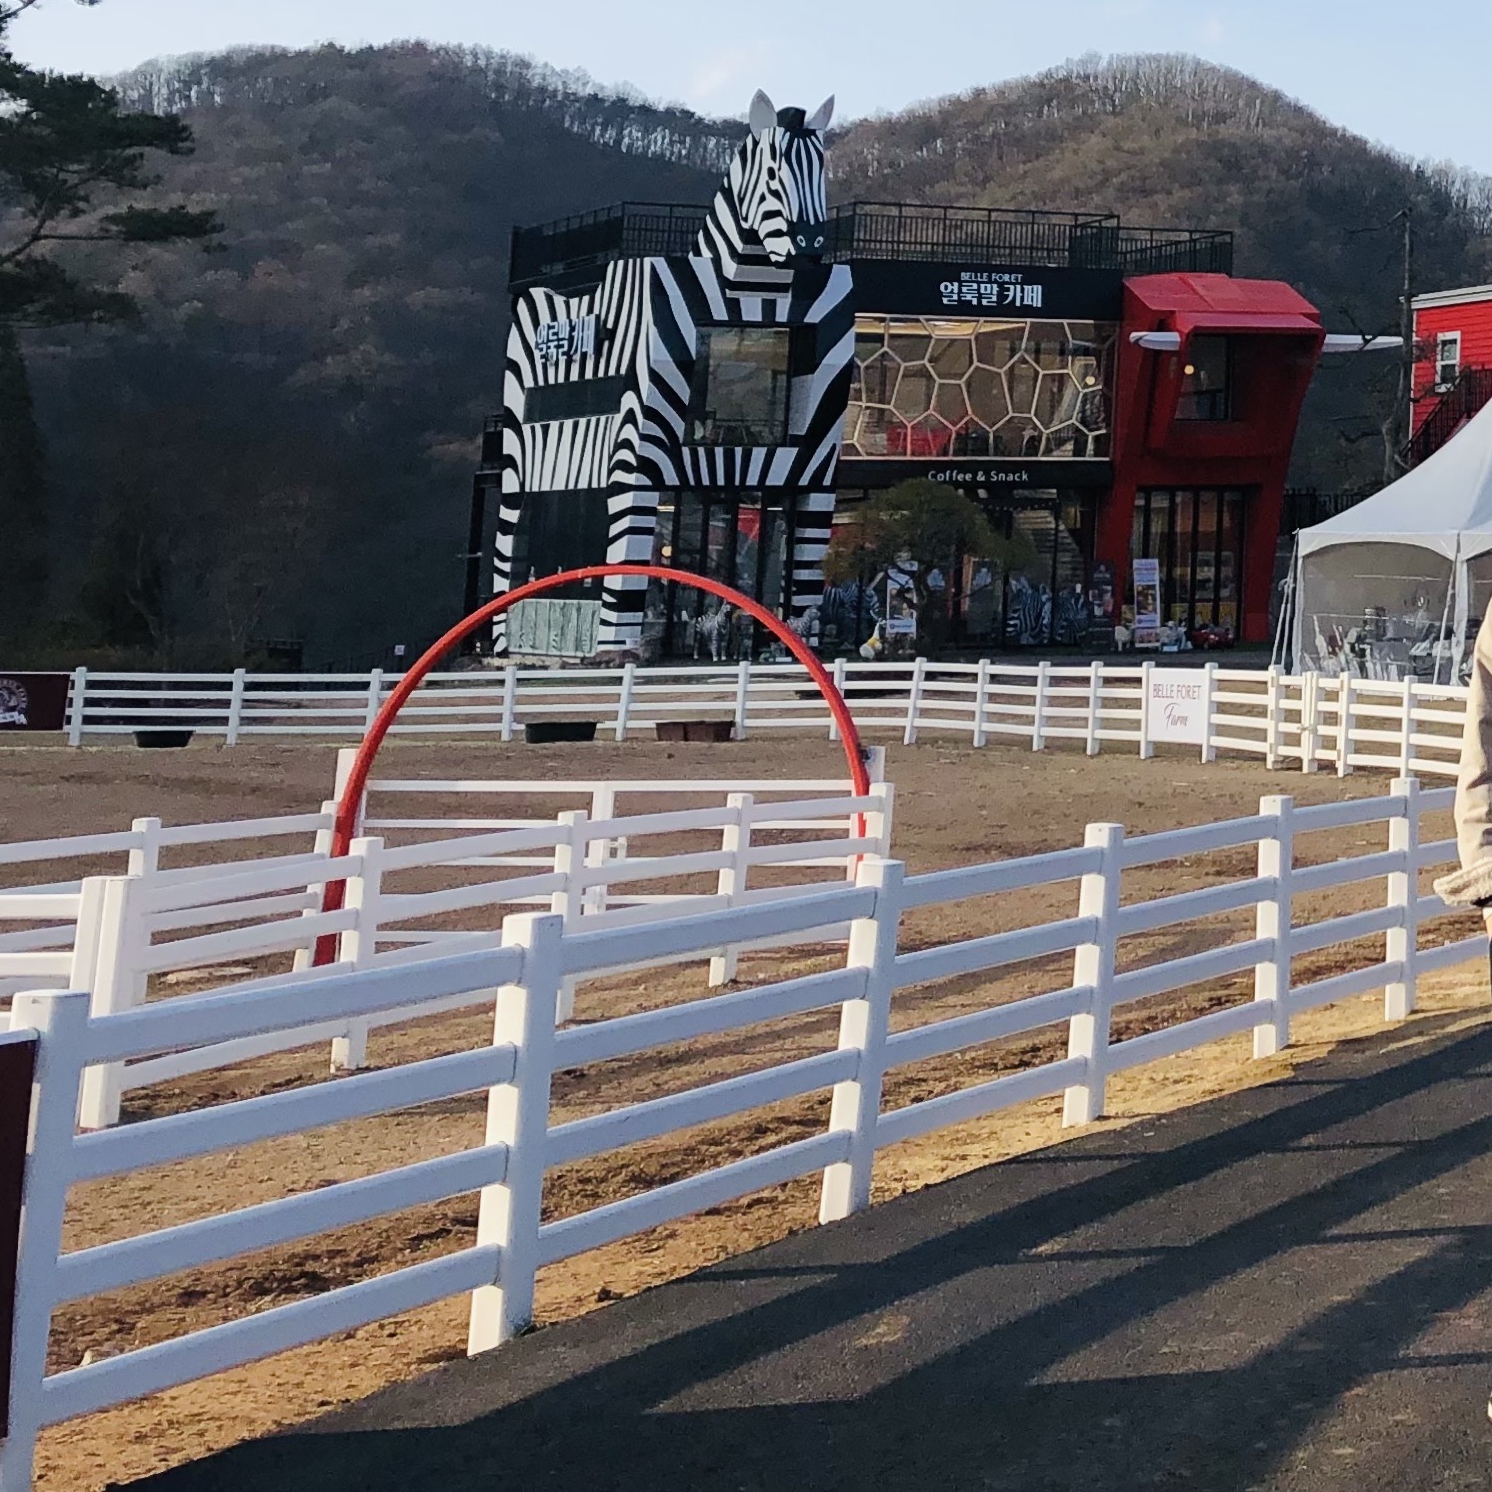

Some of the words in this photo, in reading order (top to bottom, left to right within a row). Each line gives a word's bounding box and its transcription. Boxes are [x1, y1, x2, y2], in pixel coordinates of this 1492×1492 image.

[960, 272, 989, 282] BELLE
[991, 273, 1023, 283] FORET
[940, 281, 999, 306] 얼룩말
[1002, 284, 1042, 308] 카페
[928, 470, 972, 481] Coffee
[976, 470, 986, 482] &
[990, 470, 1029, 482] Snack
[1153, 683, 1175, 699] BELLE
[1176, 684, 1202, 700] FORET
[1164, 702, 1188, 731] Farm
